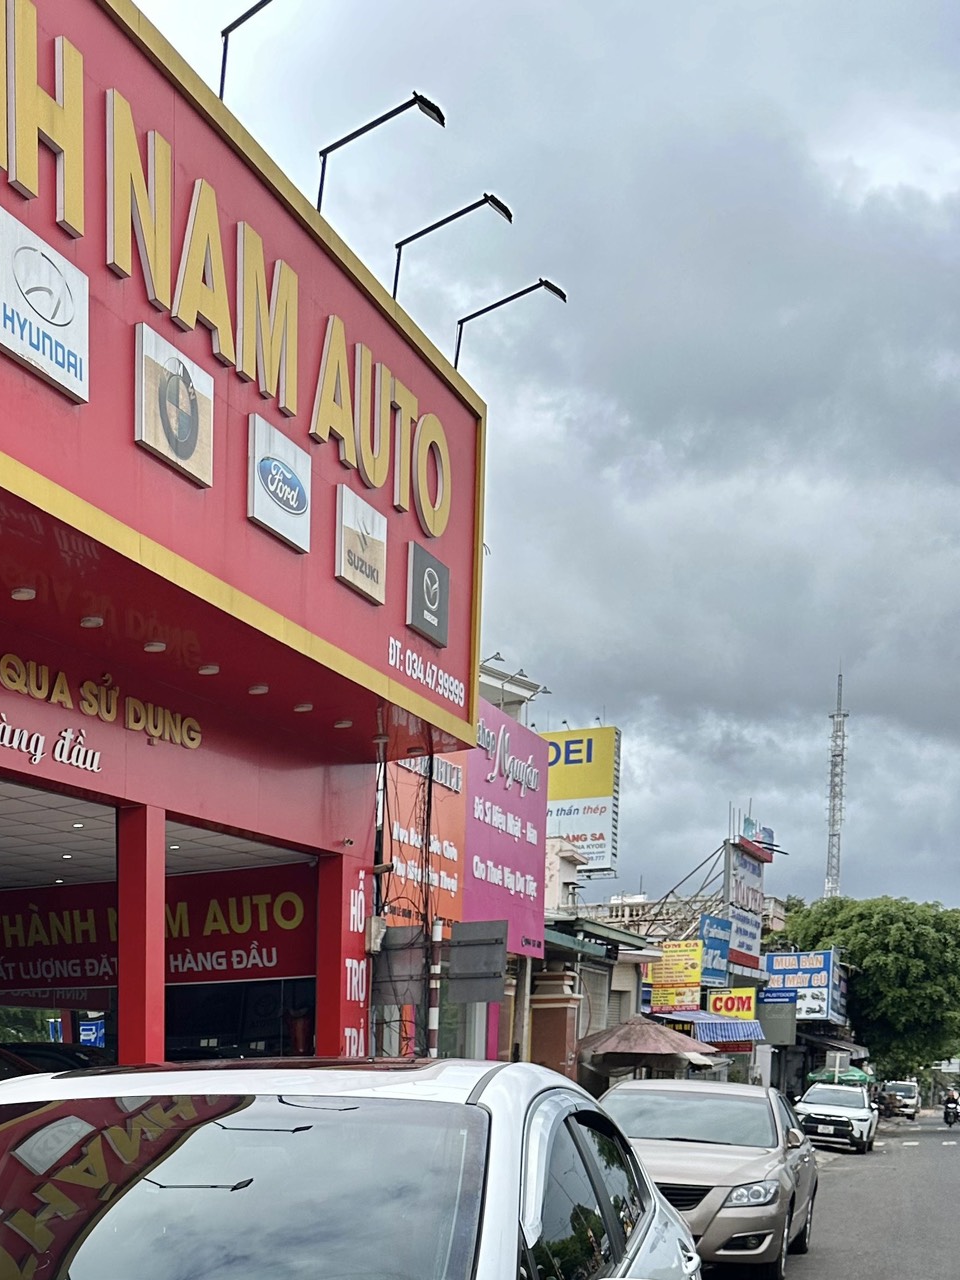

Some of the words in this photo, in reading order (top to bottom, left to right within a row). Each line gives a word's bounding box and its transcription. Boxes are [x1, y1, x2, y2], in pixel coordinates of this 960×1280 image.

[106, 87, 299, 418] NAM
[309, 314, 451, 538] AUTO
[2, 303, 84, 381] HYUNDAI
[268, 461, 300, 508] Ford
[347, 549, 380, 584] SUZUKI
[388, 636, 404, 672] ĐT:
[405, 649, 465, 707] 034.47.99999
[80, 672, 121, 723] SỬ
[126, 697, 203, 750] DỤNG
[54, 728, 103, 774] đầu
[583, 805, 607, 816] thép
[590, 832, 606, 842] SA
[202, 891, 305, 936] AUTO
[349, 870, 366, 933] HỖ
[20, 958, 80, 982] LƯỢNG
[169, 948, 227, 973] HÀNG
[231, 940, 278, 969] ĐẦU
[345, 958, 367, 1008] TRỢ
[768, 974, 784, 988] XE
[785, 972, 810, 987] MÁY
[812, 971, 828, 987] CŨ
[773, 956, 798, 969] MUA
[800, 952, 824, 969] BÁN
